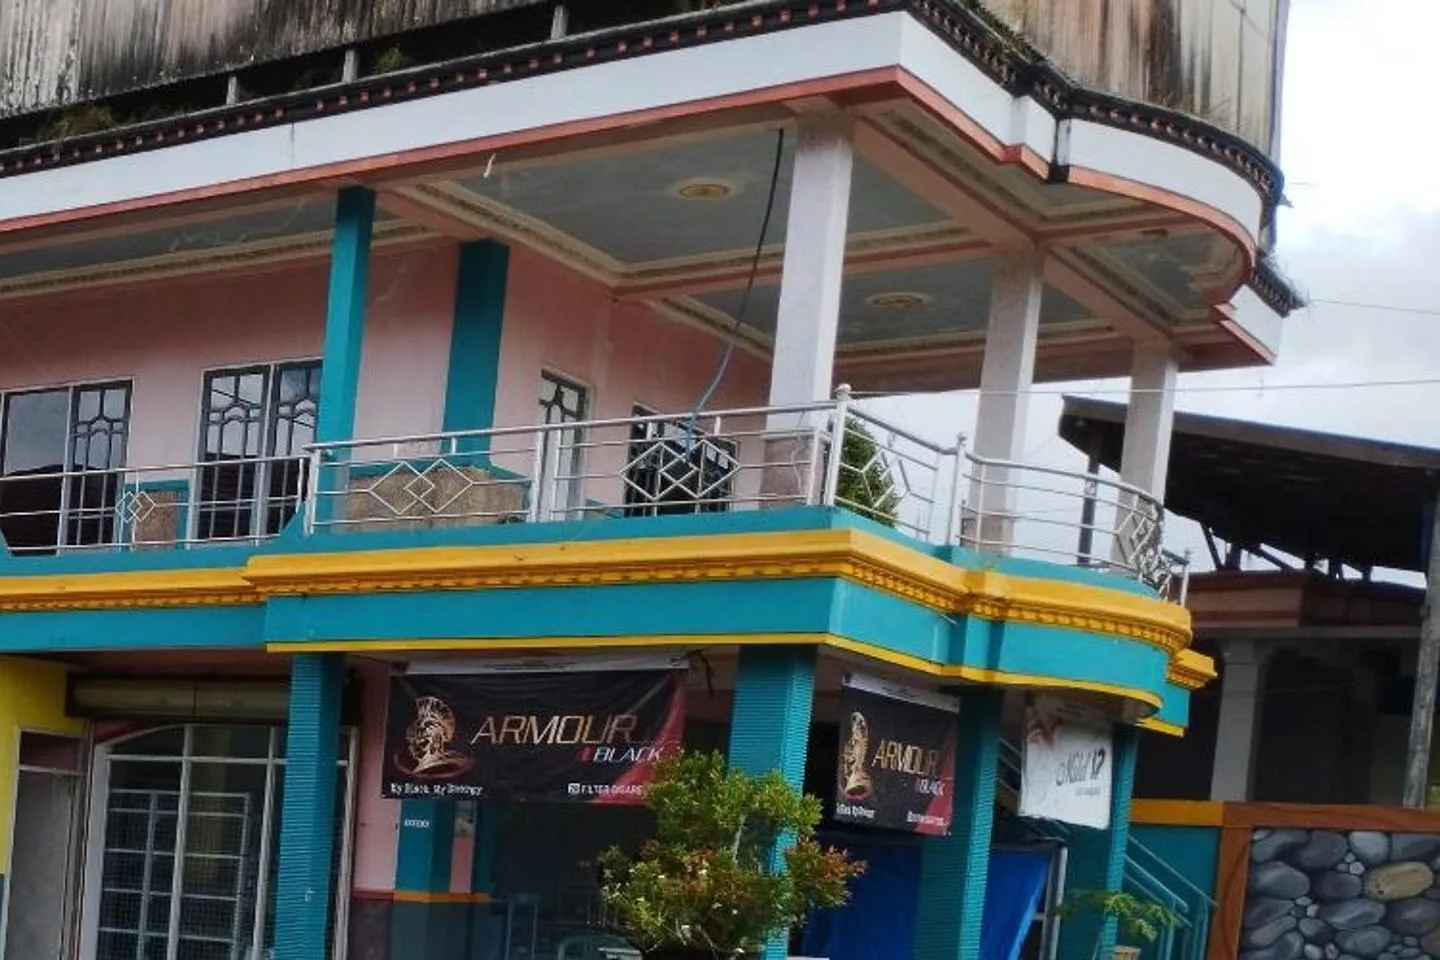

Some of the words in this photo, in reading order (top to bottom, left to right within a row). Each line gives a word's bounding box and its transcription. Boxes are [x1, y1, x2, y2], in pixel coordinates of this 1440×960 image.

[471, 715, 637, 745] ARMOUR
[593, 746, 665, 763] BLACK
[871, 738, 939, 778] ARMOUR
